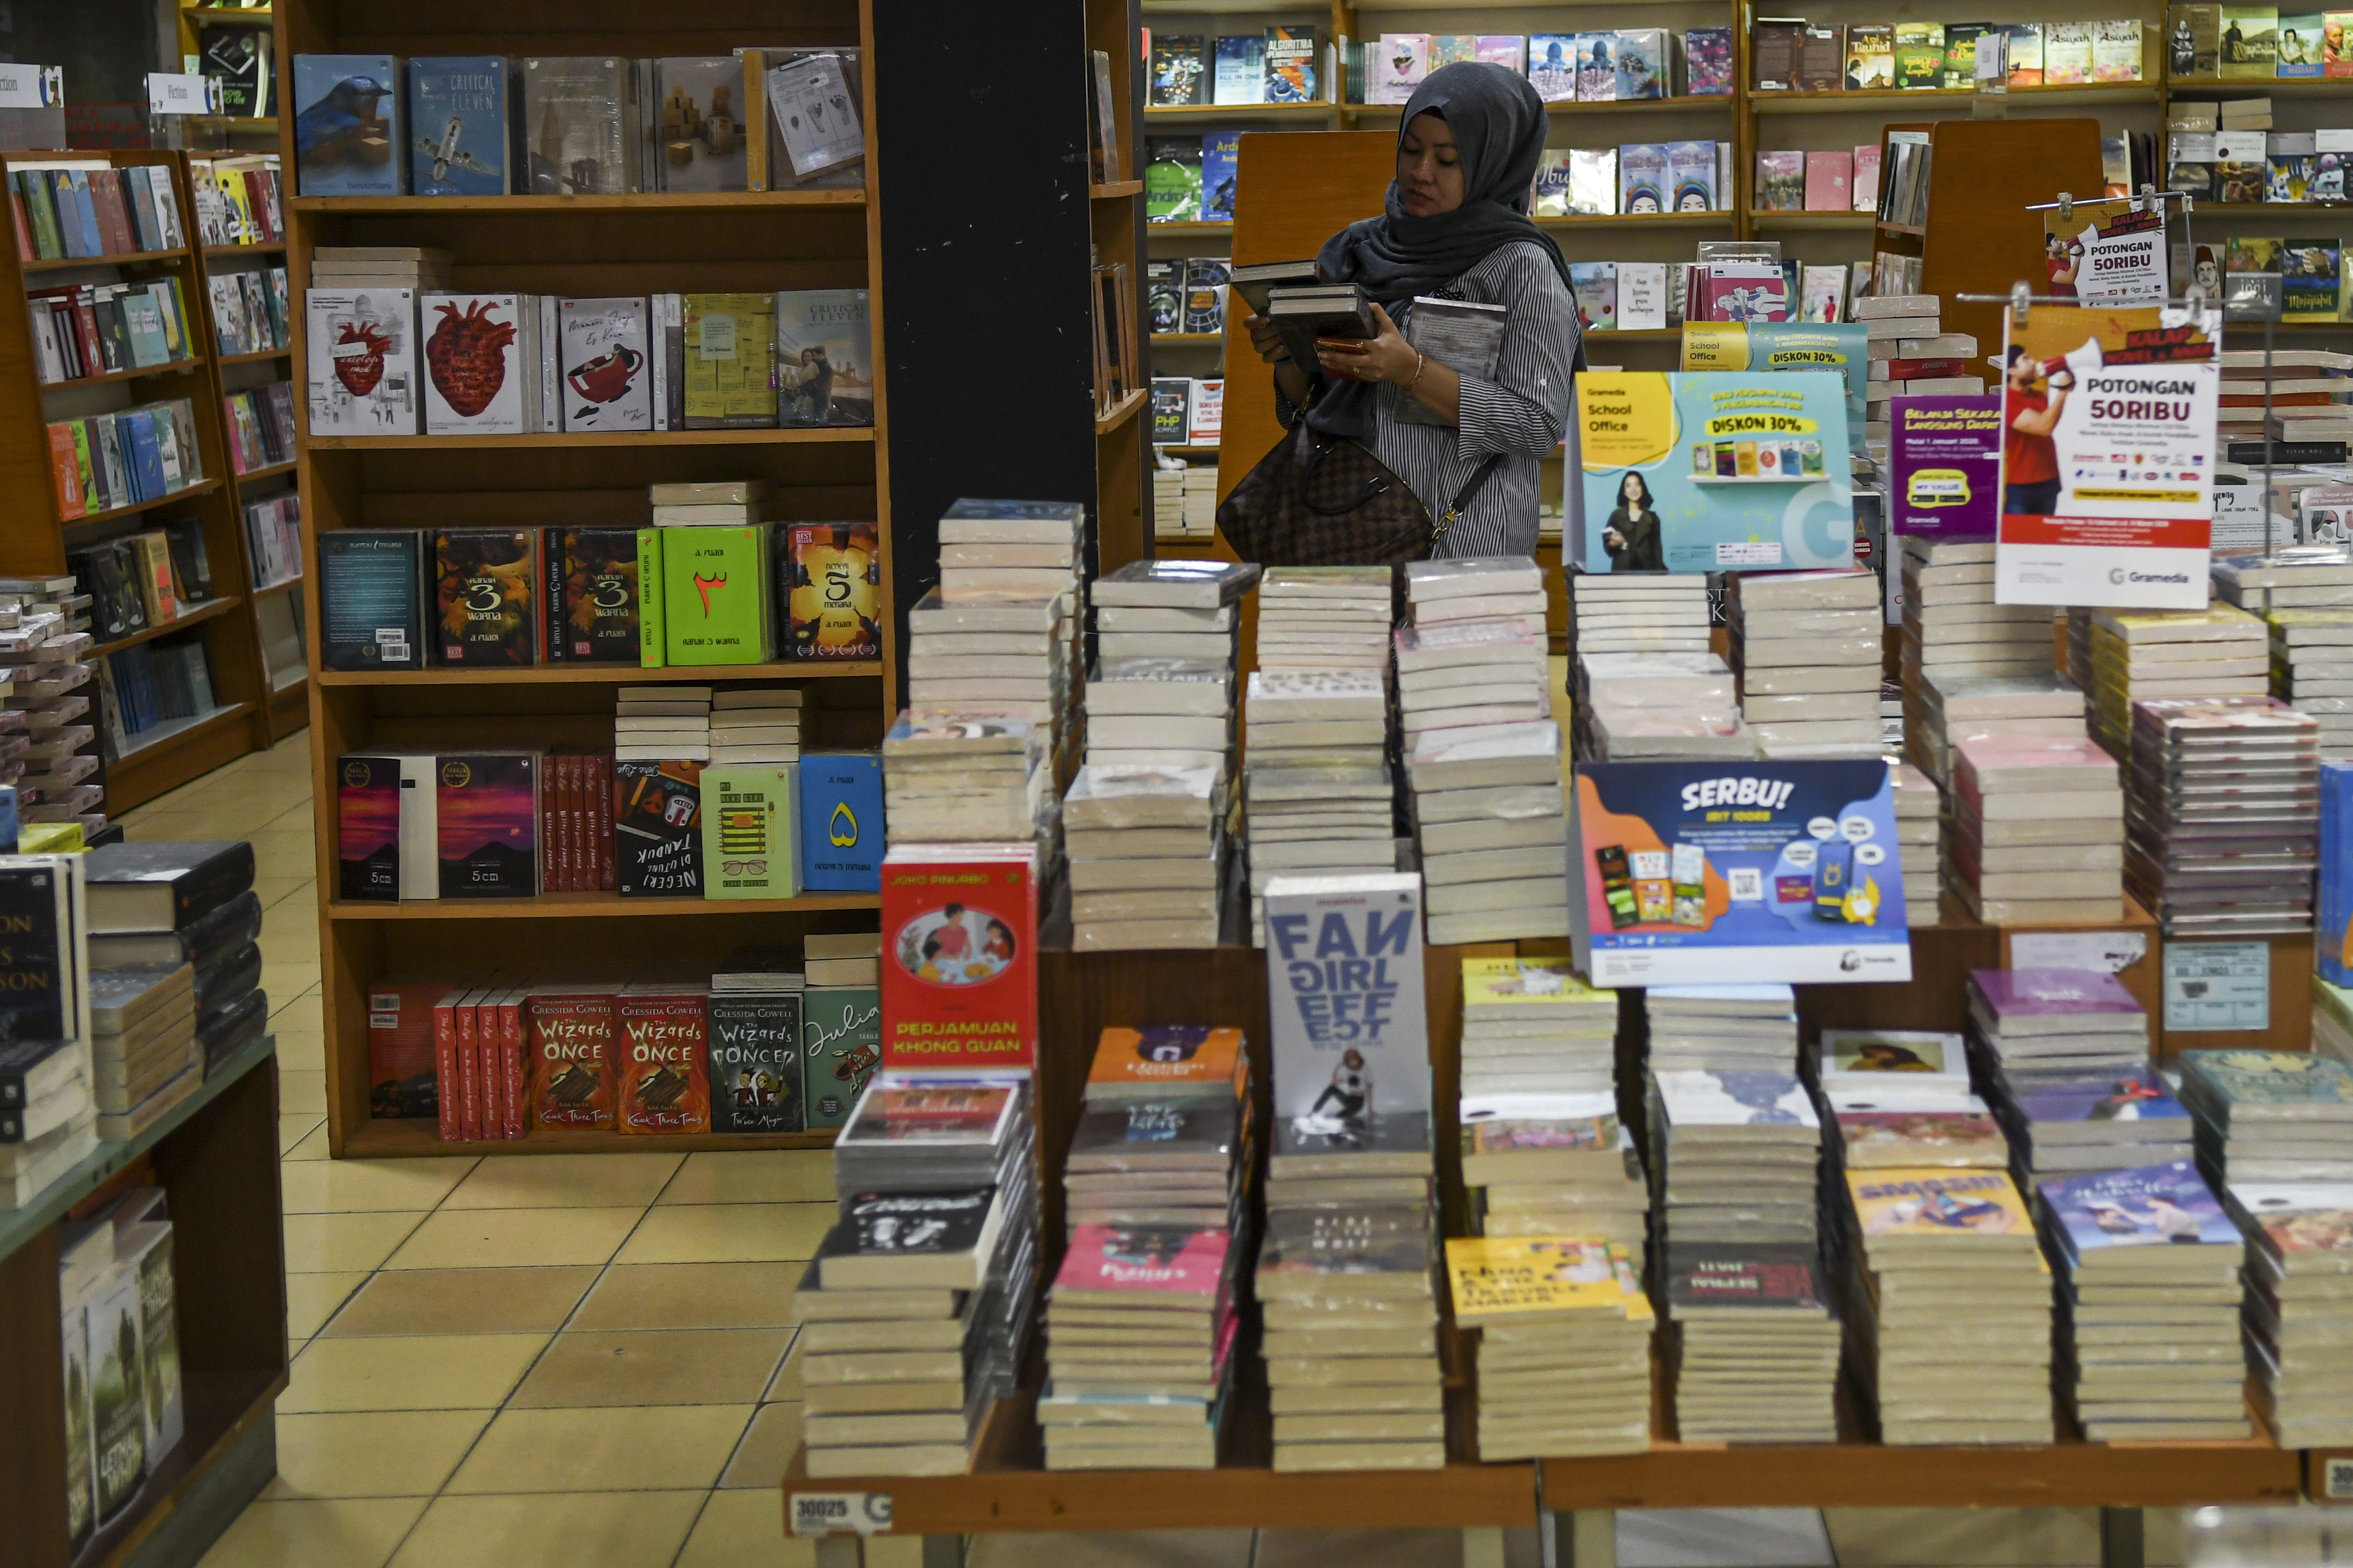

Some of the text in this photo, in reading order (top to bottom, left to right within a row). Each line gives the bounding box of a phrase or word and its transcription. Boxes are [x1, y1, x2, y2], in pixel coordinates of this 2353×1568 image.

[0, 76, 18, 92] ction
[451, 75, 495, 90] CRITICAL
[168, 84, 188, 99] Fiction
[451, 94, 493, 110] ELEVEN
[2112, 211, 2148, 226] KALAP
[2137, 218, 2161, 230] ANAK
[2091, 242, 2152, 256] POTONGAN
[810, 304, 865, 313] CRITICAL
[812, 312, 864, 321] ELEVEN
[1774, 352, 1836, 363] DISKON 30%
[2087, 378, 2196, 395] POTONGAN
[1588, 404, 1632, 415] School
[1155, 415, 1180, 427] PHP
[1589, 422, 1628, 432] Office
[1712, 416, 1802, 433] DISKON 30%
[2129, 571, 2189, 584] Gramedia
[465, 584, 501, 611] 3
[593, 581, 628, 608] 3
[721, 795, 741, 803] NERD
[1681, 777, 1795, 811] SERBU!
[636, 833, 691, 864] TANDUK
[646, 854, 691, 873] DI UJUNG
[642, 869, 696, 889] NEGERI
[891, 873, 989, 886] JOKO PINURBO
[1269, 910, 1415, 960] FAN
[1288, 959, 1399, 993] GIRL
[532, 1005, 611, 1015] CRESSIDA COWELL
[621, 1006, 703, 1016] CRESSIDA COWELL
[714, 1008, 793, 1018] CRESSIDA COWELL
[537, 1020, 611, 1039] Wizards
[626, 1020, 701, 1040] Wizards
[718, 1023, 792, 1043] Wizards
[805, 1005, 881, 1057] Julia
[896, 1022, 1017, 1036] PERJAMUAN
[544, 1042, 602, 1060] ONCE
[632, 1043, 692, 1062] ONCE
[893, 1039, 1021, 1054] KHONG GUAN
[725, 1046, 784, 1063] ONCE
[539, 1109, 614, 1123] Knock Three Times
[627, 1113, 702, 1126] Knock Three Times
[730, 1112, 784, 1128] Twice Magic
